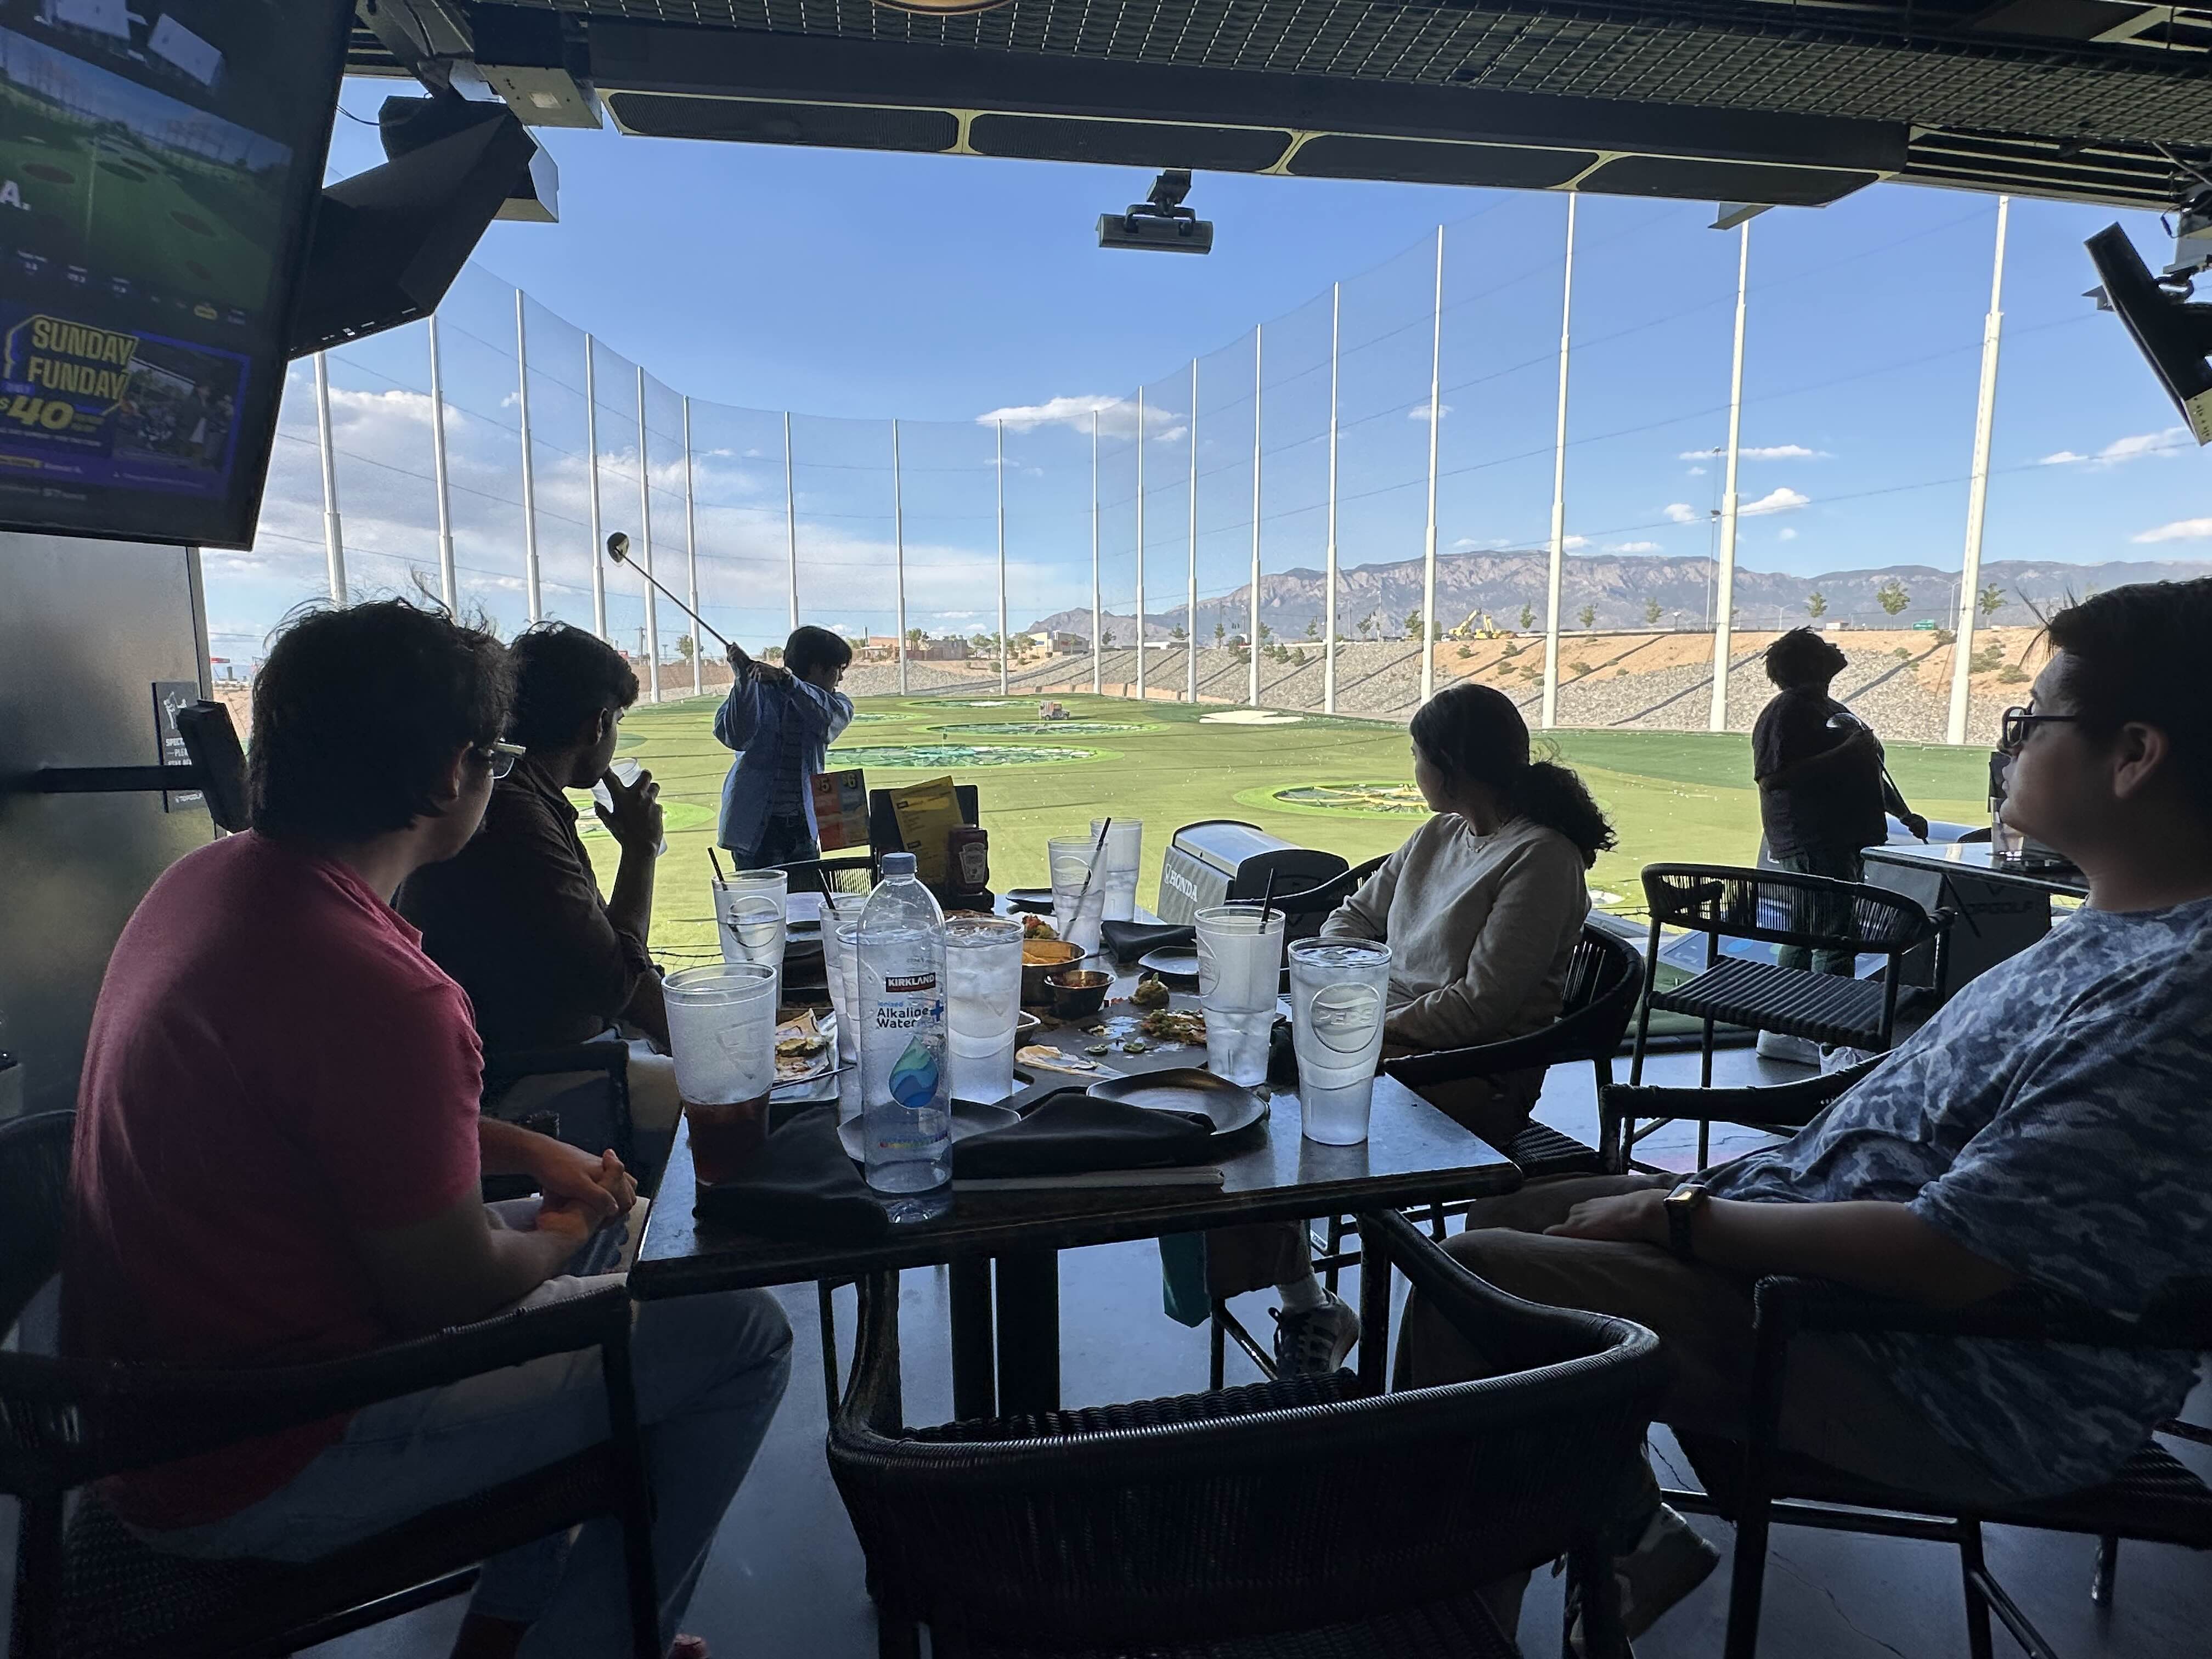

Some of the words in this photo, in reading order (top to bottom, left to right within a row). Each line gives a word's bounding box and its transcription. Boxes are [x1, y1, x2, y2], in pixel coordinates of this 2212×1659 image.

[31, 319, 134, 365] SUNDAY
[27, 356, 128, 400] FUNDAY
[1169, 869, 1198, 903] HONDA
[888, 974, 935, 987] KIRKLAND
[877, 1007, 929, 1018] Alkaline
[1314, 1006, 1379, 1026] PEPSI
[877, 1018, 918, 1029] Water
